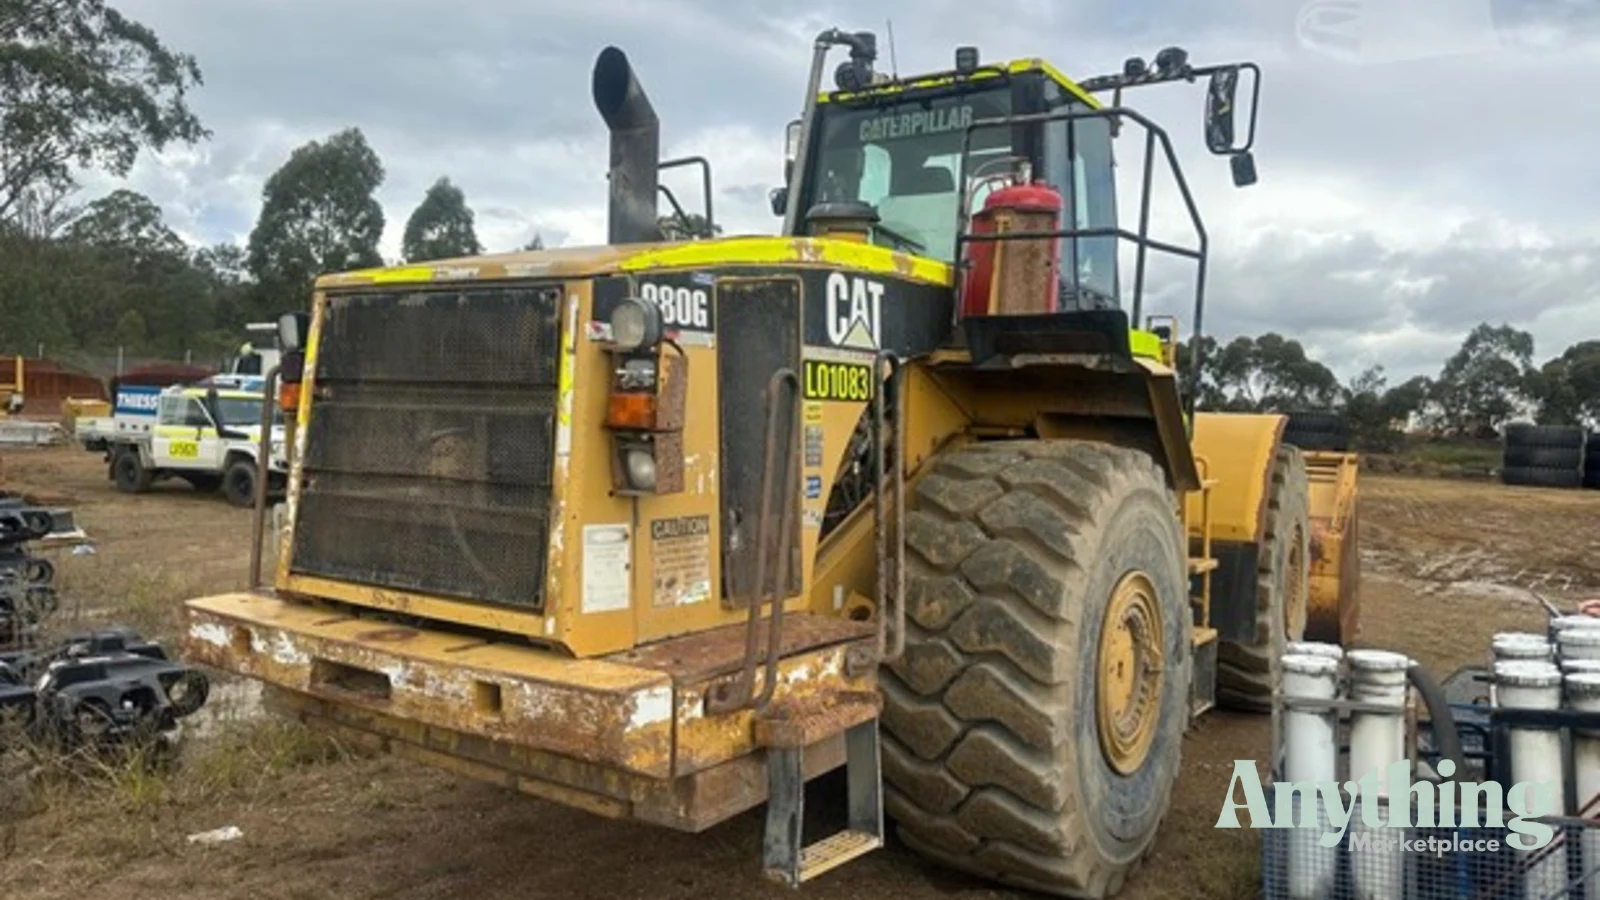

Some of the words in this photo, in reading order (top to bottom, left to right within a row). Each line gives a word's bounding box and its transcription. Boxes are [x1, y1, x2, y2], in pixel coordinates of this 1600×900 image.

[860, 105, 973, 141] CATERPILLAR
[826, 271, 884, 350] CAT
[653, 518, 709, 537] CAUTION
